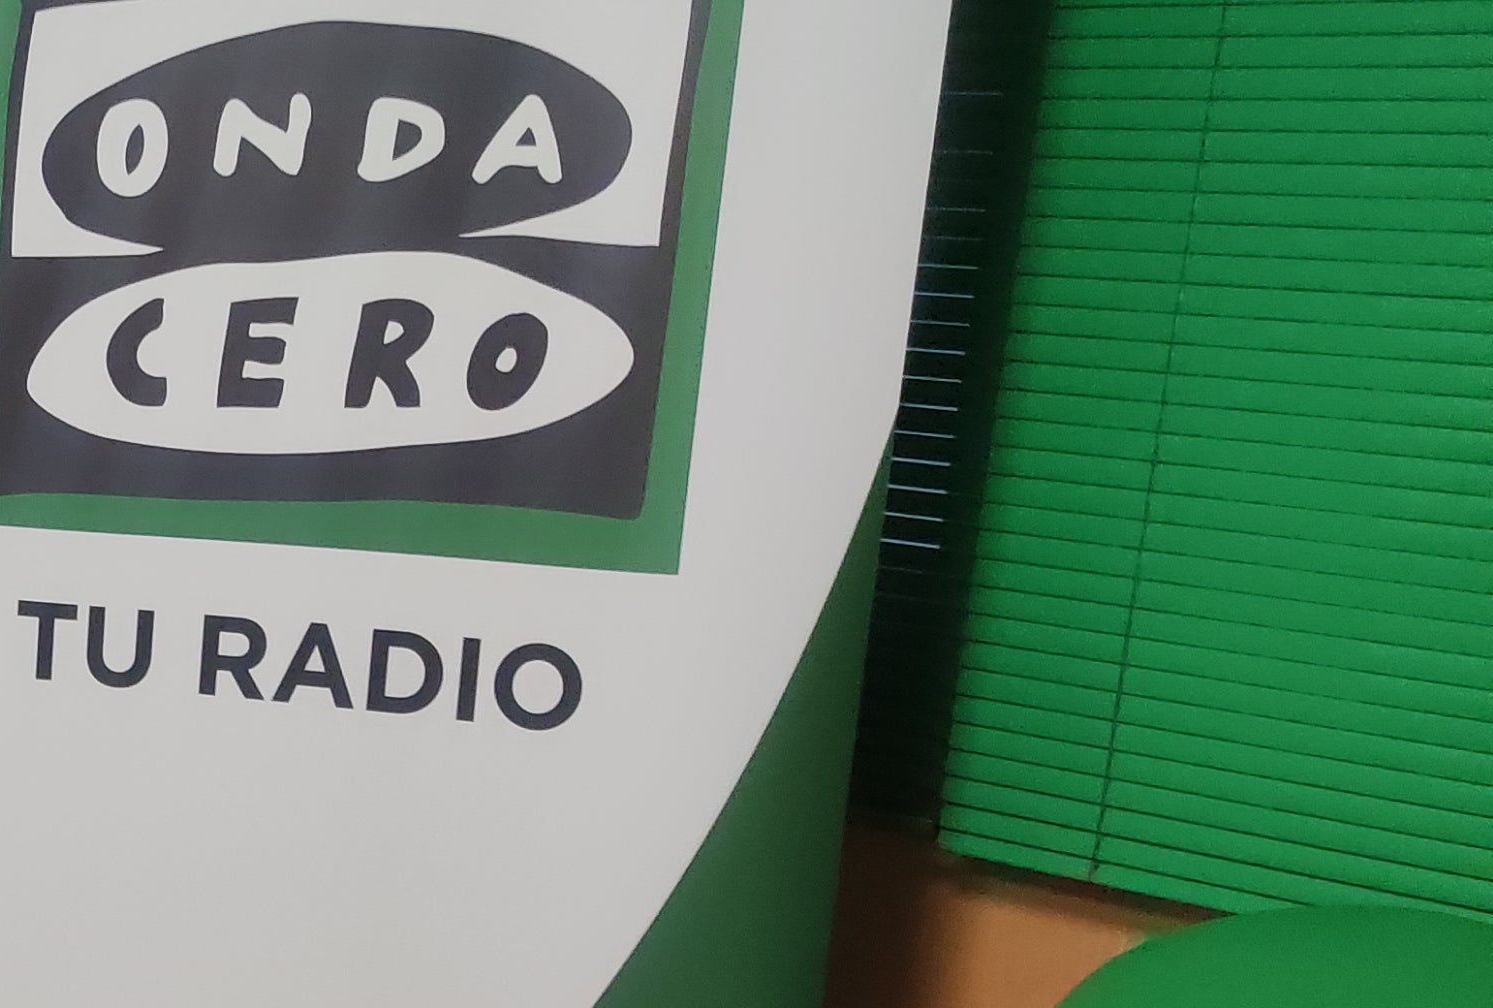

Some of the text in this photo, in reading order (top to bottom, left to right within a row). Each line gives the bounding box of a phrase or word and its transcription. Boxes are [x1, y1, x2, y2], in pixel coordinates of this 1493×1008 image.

[96, 92, 563, 198] ONDA
[105, 296, 550, 411] CERO
[17, 600, 584, 732] TU RADIO
